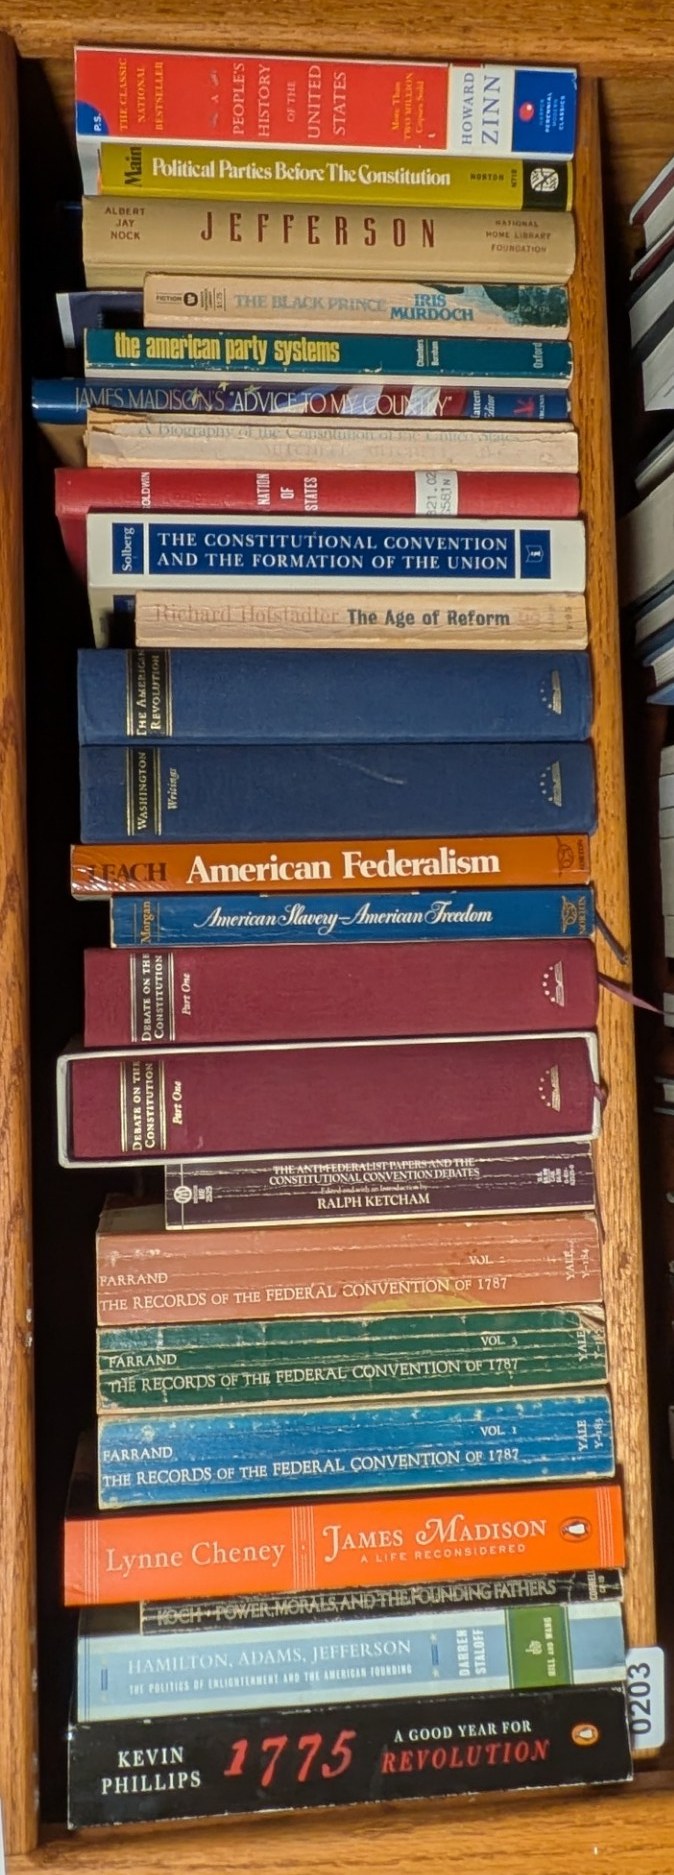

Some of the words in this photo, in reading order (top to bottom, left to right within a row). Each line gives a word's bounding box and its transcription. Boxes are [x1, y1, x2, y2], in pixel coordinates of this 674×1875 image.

[119, 58, 128, 111] CLASSIC
[136, 67, 145, 122] NATIONAL
[156, 61, 165, 131] BESTSELLER
[287, 81, 296, 105] THE
[392, 82, 400, 103] Than
[404, 72, 413, 119] MILLION
[416, 81, 424, 102] Sold
[232, 62, 246, 135] PEOPLE'S
[258, 64, 271, 137] HISTORY
[307, 65, 322, 139] UNITED
[333, 71, 346, 136] STATES
[461, 72, 475, 145] HOWARD
[482, 75, 500, 145] ZINN
[94, 113, 102, 132] P.S.
[119, 112, 128, 132] THE
[287, 108, 295, 122] OF
[392, 105, 400, 130] More
[125, 146, 142, 188] Main
[152, 157, 215, 178] Political
[219, 159, 273, 180] Parties
[275, 161, 325, 181] Before
[326, 163, 356, 182] The
[358, 164, 451, 186] Constitution
[470, 173, 505, 181] NORTON
[104, 207, 145, 216] ALBERT
[116, 219, 134, 228] JAY
[495, 220, 539, 229] NATIONAL
[110, 231, 140, 240] NOCK
[200, 211, 435, 248] JEFFERSON
[486, 231, 511, 239] HOME
[514, 231, 552, 240] LIBRARY
[491, 243, 547, 253] FOUNDATION
[156, 294, 182, 302] FICTION
[234, 293, 267, 308] THE
[272, 294, 324, 310] BLACK
[327, 297, 386, 312] PRINCE
[414, 293, 446, 308] IRIS
[390, 306, 474, 321] MURDOCH
[115, 331, 140, 361] the
[146, 332, 221, 361] american
[225, 335, 268, 365] party
[274, 337, 341, 365] systems
[533, 343, 543, 369] Oxford
[75, 387, 124, 412] JAMES
[128, 388, 226, 412] MADISON'S
[303, 393, 325, 415] TO
[256, 473, 270, 505] NATION
[281, 487, 294, 499] OF
[303, 477, 318, 511] STATES
[122, 527, 135, 571] Solberg
[157, 532, 197, 546] THE
[204, 533, 377, 550] CONSTITUTIONAL
[383, 536, 508, 551] CONVENTION
[157, 553, 198, 566] AND
[205, 553, 244, 567] THE
[252, 554, 364, 569] FORMATION
[371, 555, 396, 569] OF
[402, 556, 440, 569] THE
[447, 556, 508, 570] UNION
[155, 604, 232, 623] Richard
[347, 609, 378, 625] The
[385, 609, 415, 628] Age
[422, 609, 440, 625] of
[448, 609, 510, 626] Reform
[150, 655, 162, 730] REVOLUTION
[137, 751, 147, 830] WASHINGTON
[167, 768, 180, 810] Writings
[186, 854, 332, 884] American
[342, 847, 501, 879] Federalism
[140, 901, 154, 944] Morgan
[193, 906, 276, 928] American
[425, 901, 493, 924] Freedom
[142, 953, 150, 974] THE
[143, 979, 150, 994] ON
[182, 973, 191, 991] One
[154, 955, 163, 1040] CONSTITUTION
[182, 994, 192, 1016] Part
[141, 998, 152, 1041] DEBATE
[132, 1062, 141, 1083] THE
[134, 1087, 142, 1103] ON
[172, 1081, 182, 1101] One
[145, 1063, 155, 1149] CONSTITUTION
[172, 1103, 183, 1125] Part
[132, 1109, 143, 1151] DEBATE
[269, 1173, 363, 1186] CONSTITUTIONAL
[363, 1171, 434, 1183] CONVENTION
[435, 1167, 480, 1179] DEBATES
[273, 1165, 295, 1175] THE
[390, 1160, 428, 1170] PAPERS
[429, 1159, 453, 1168] AND
[454, 1158, 475, 1167] THE
[318, 1196, 362, 1209] RALPH
[365, 1193, 430, 1207] KETCHAM
[100, 1273, 168, 1287] FARRAND
[133, 1293, 207, 1309] RECORDS
[266, 1285, 336, 1301] FEDERAL
[343, 1279, 450, 1297] CONVENTION
[455, 1279, 473, 1291] OF
[477, 1278, 507, 1290] 1787
[576, 1331, 588, 1362] YALE
[108, 1353, 177, 1368] FARRAND
[142, 1374, 215, 1391] RECORDS
[276, 1366, 347, 1383] FEDERAL
[352, 1360, 460, 1379] CONVENTION
[489, 1359, 518, 1371] 1787
[577, 1419, 588, 1451] YALE
[103, 1447, 173, 1462] FARRAND
[137, 1468, 211, 1485] RECORDS
[273, 1458, 344, 1475] FEDERAL
[350, 1451, 460, 1471] CONVENTION
[489, 1448, 519, 1462] 1787
[322, 1525, 403, 1562] JAMES
[415, 1514, 547, 1544] MADISON
[106, 1547, 184, 1577] Lynne
[191, 1541, 285, 1567] Cheney
[361, 1555, 368, 1563] A
[376, 1551, 407, 1563] LIFE
[415, 1543, 526, 1560] RECONSIDERED
[157, 1607, 201, 1626] KOCH
[411, 1582, 492, 1605] FOUNDING
[494, 1579, 557, 1599] FATHERS
[544, 1617, 553, 1639] WANG
[128, 1654, 234, 1675] HAMILTON,
[238, 1647, 306, 1667] ADAMS,
[310, 1639, 411, 1665] JEFFERSON
[456, 1629, 469, 1677] DARREN
[473, 1628, 487, 1675] STALOFF
[546, 1642, 555, 1655] AND
[129, 1685, 144, 1695] THE
[149, 1681, 190, 1695] POLITICS
[193, 1680, 204, 1690] OF
[208, 1674, 280, 1689] ENLIGHTENMENT
[284, 1672, 300, 1683] AND
[304, 1671, 320, 1681] THE
[324, 1665, 366, 1679] AMERICAN
[370, 1664, 412, 1677] FOUNDING
[547, 1658, 556, 1677] HILL
[627, 1662, 651, 1735] 0203
[394, 1730, 404, 1743] A
[408, 1724, 452, 1742] GOOD
[457, 1722, 497, 1738] YEAR
[502, 1719, 532, 1734] FOR
[118, 1746, 184, 1768] KEVIN
[223, 1729, 357, 1788] 1775
[380, 1739, 550, 1774] REVOLUTION
[101, 1770, 201, 1795] PHILLIPS
